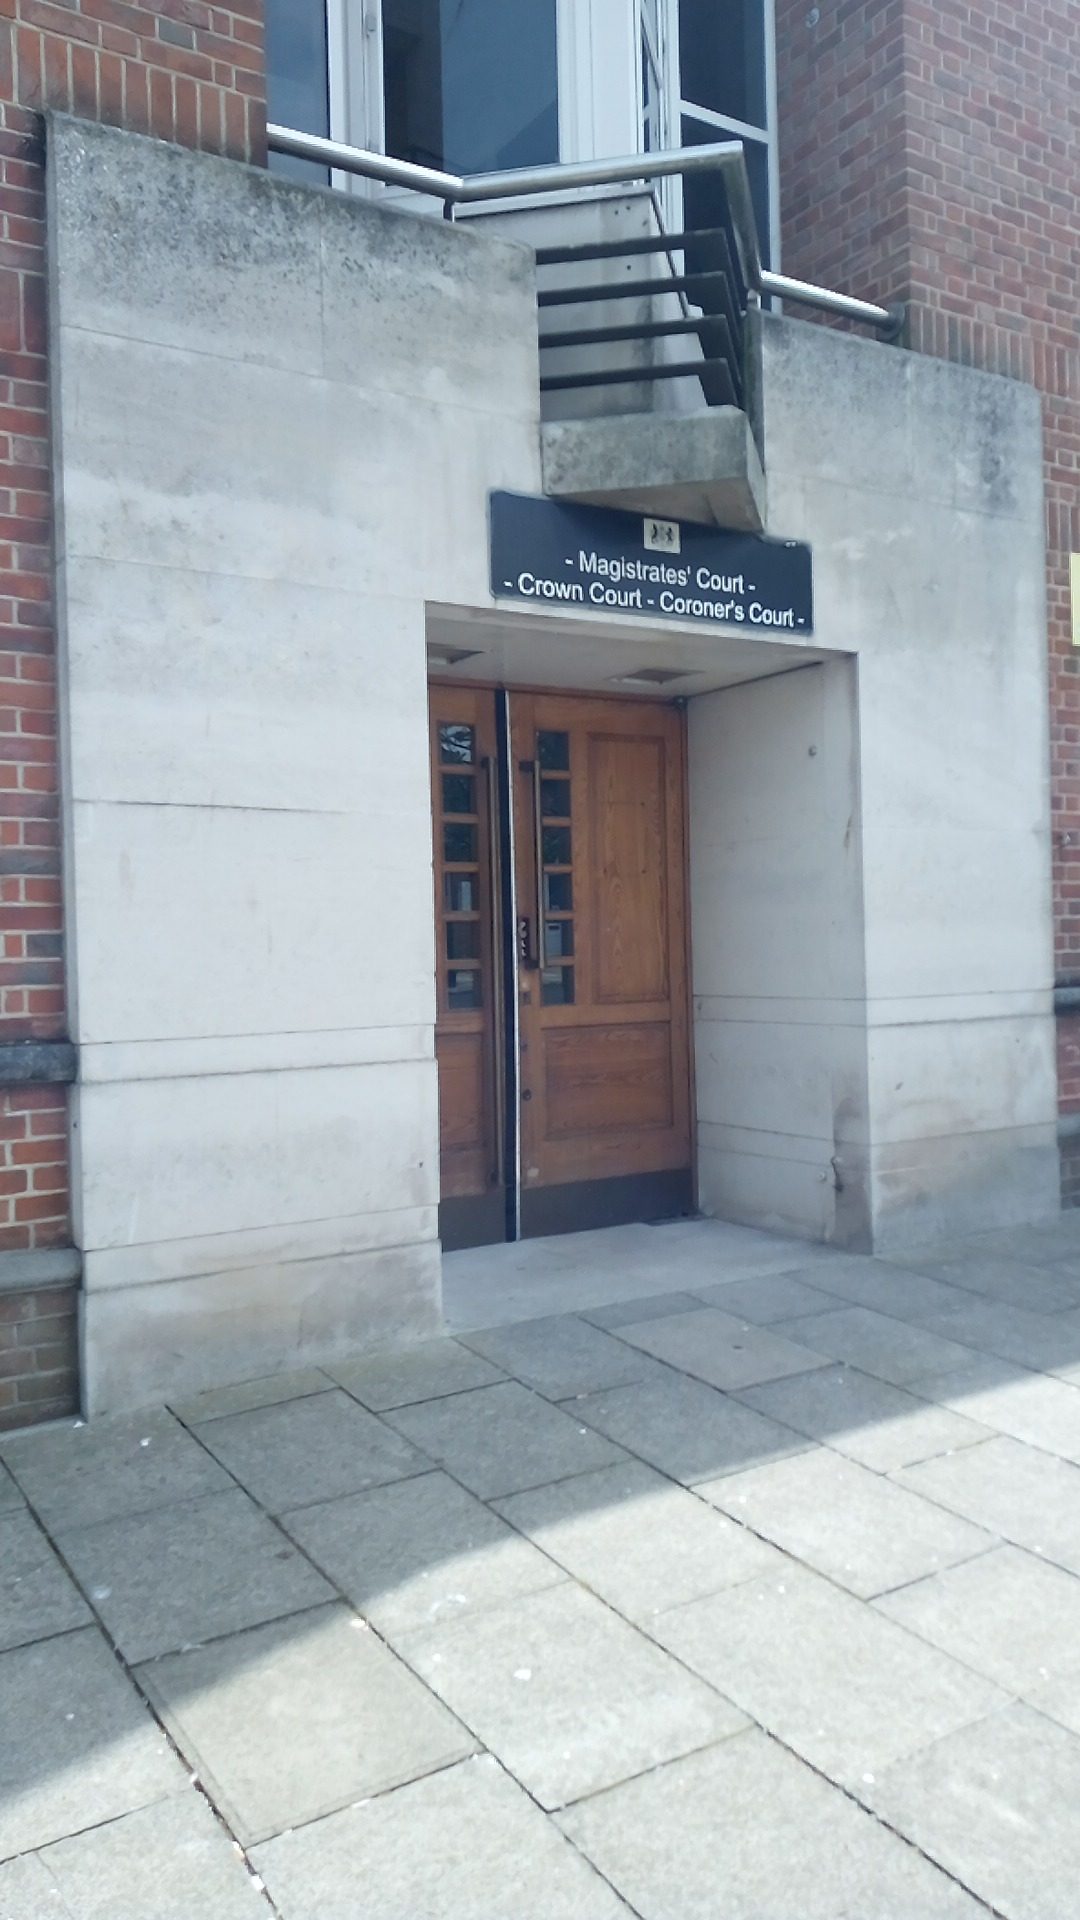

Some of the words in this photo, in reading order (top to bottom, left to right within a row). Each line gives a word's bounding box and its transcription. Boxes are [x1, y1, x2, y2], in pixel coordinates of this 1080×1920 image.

[579, 550, 691, 587] Magistrates'
[696, 568, 744, 594] Court
[517, 572, 584, 601] Crown
[589, 582, 643, 609] Court
[659, 590, 745, 622] Coroner's
[749, 602, 794, 628] Court
